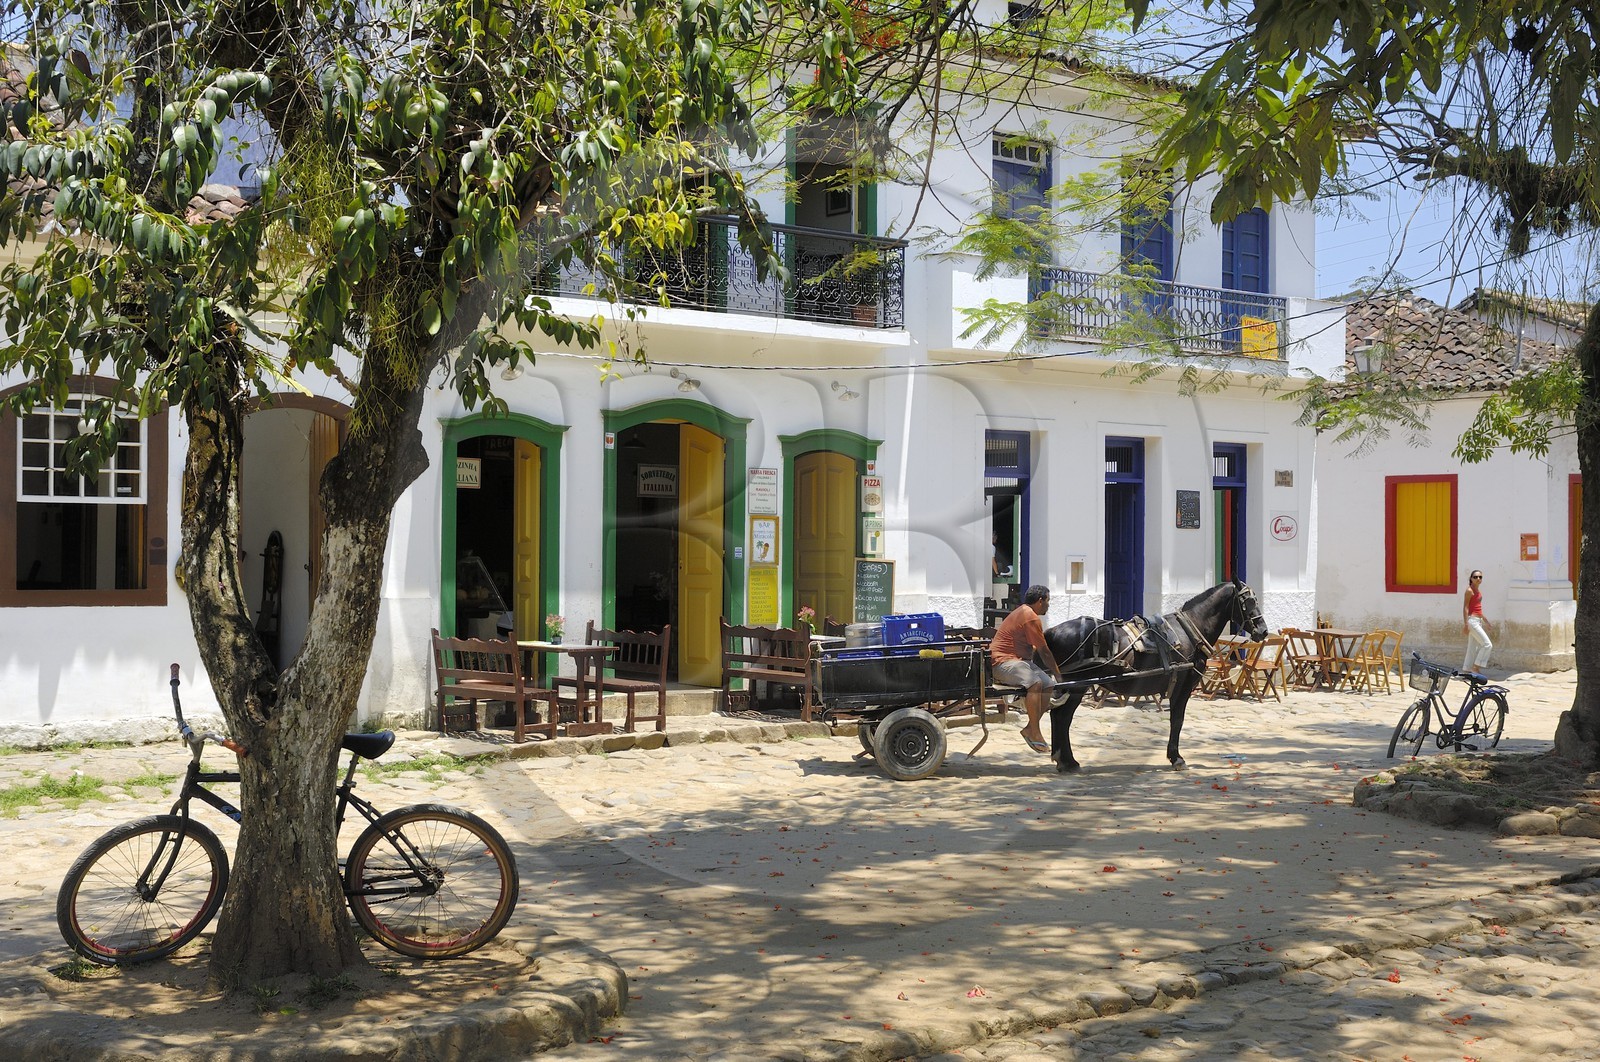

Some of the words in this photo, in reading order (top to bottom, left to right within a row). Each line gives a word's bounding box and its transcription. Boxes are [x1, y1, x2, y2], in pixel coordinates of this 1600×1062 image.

[1244, 320, 1275, 333] VENDE-SE
[457, 461, 477, 472] ZINHA
[643, 483, 673, 492] ITALIANA
[864, 479, 881, 487] PIZZA
[899, 631, 929, 640] ANTARCTICA
